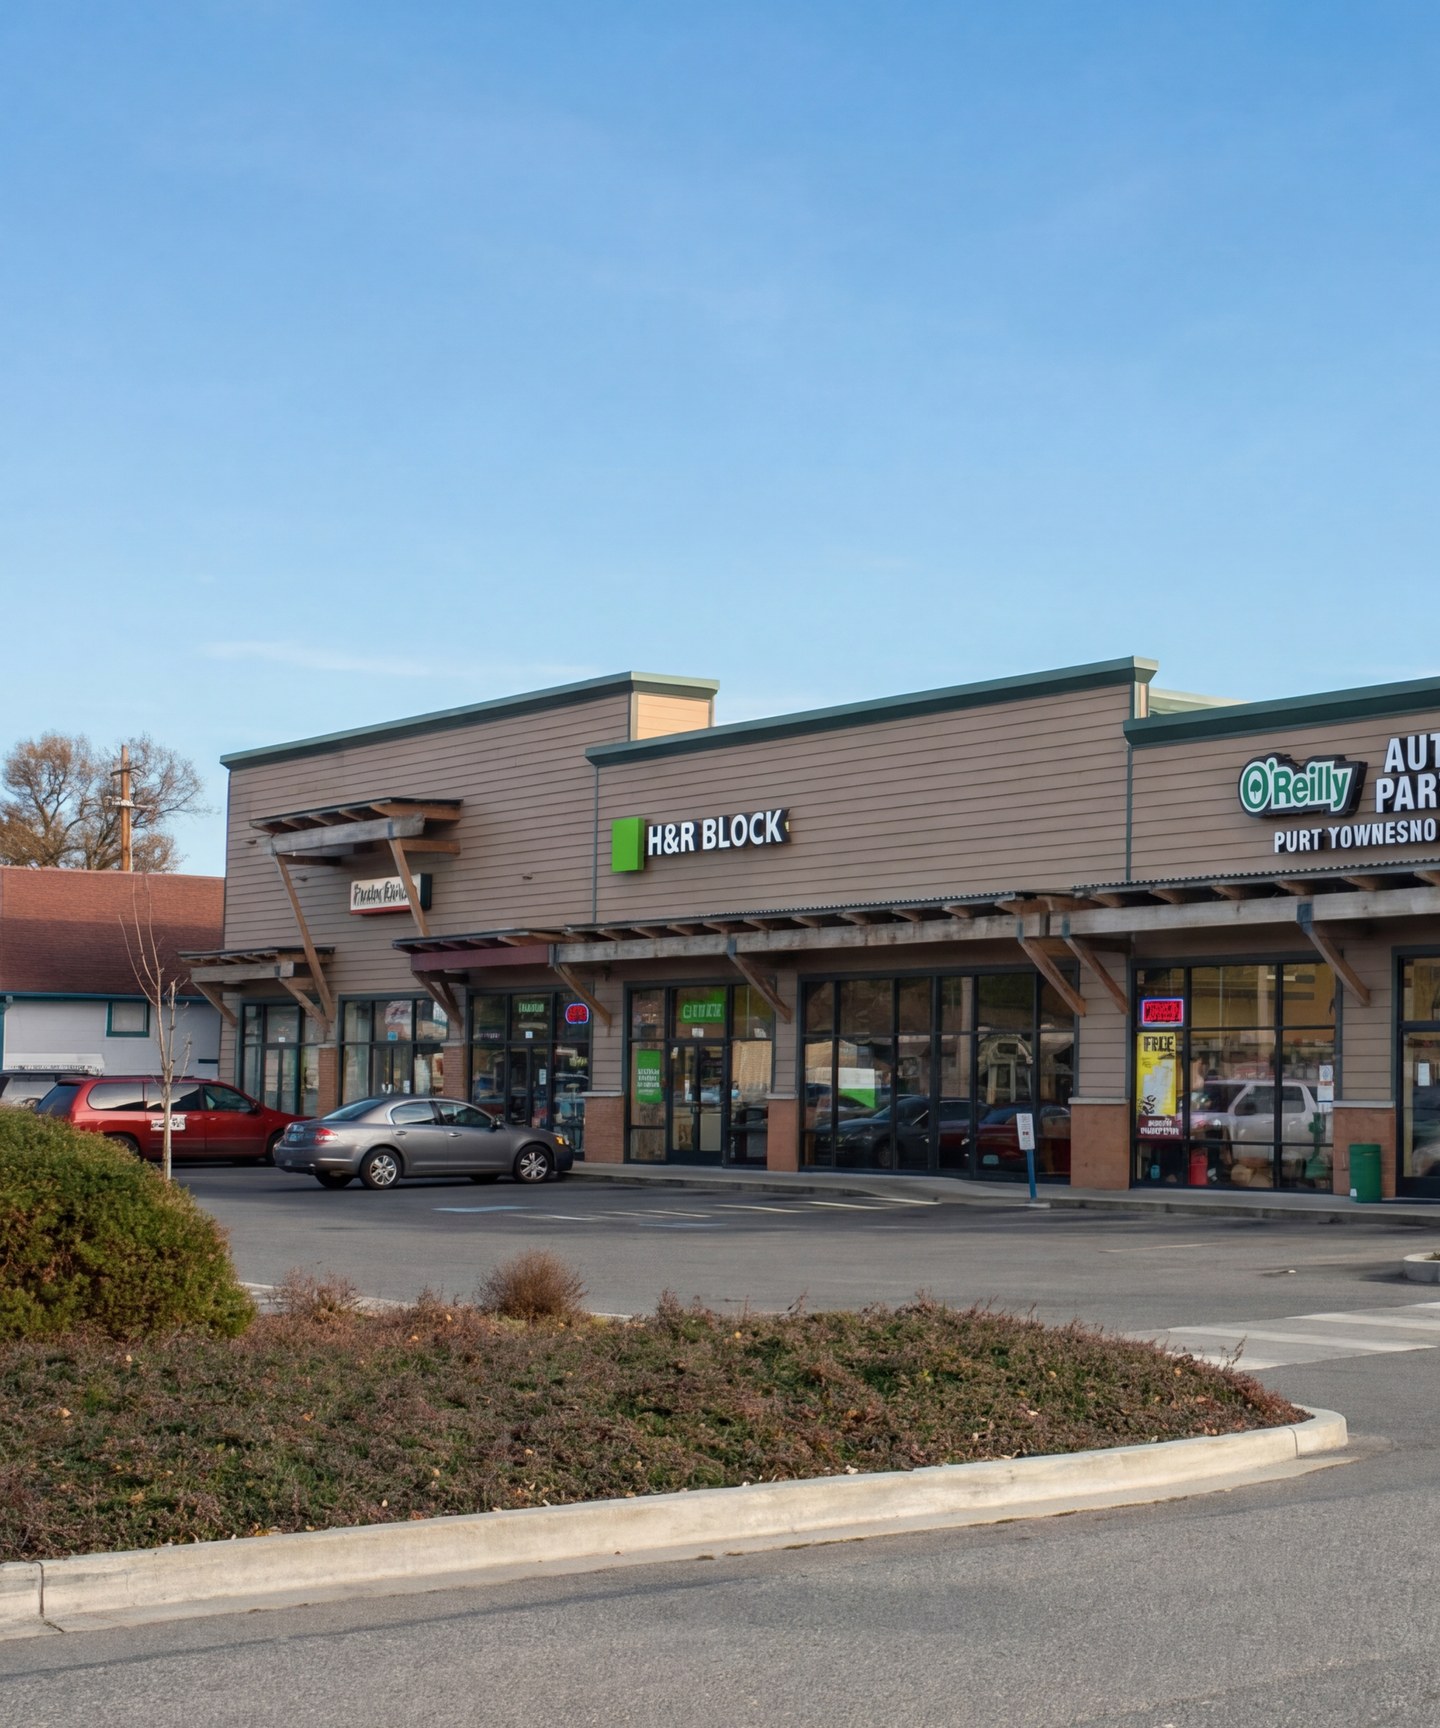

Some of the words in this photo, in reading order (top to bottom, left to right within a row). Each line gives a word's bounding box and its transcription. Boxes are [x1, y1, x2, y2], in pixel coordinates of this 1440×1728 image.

[1241, 759, 1351, 811] O'Reilly
[648, 821, 695, 856] H&R
[702, 809, 784, 850] BLOCK
[1274, 828, 1323, 853] PURT
